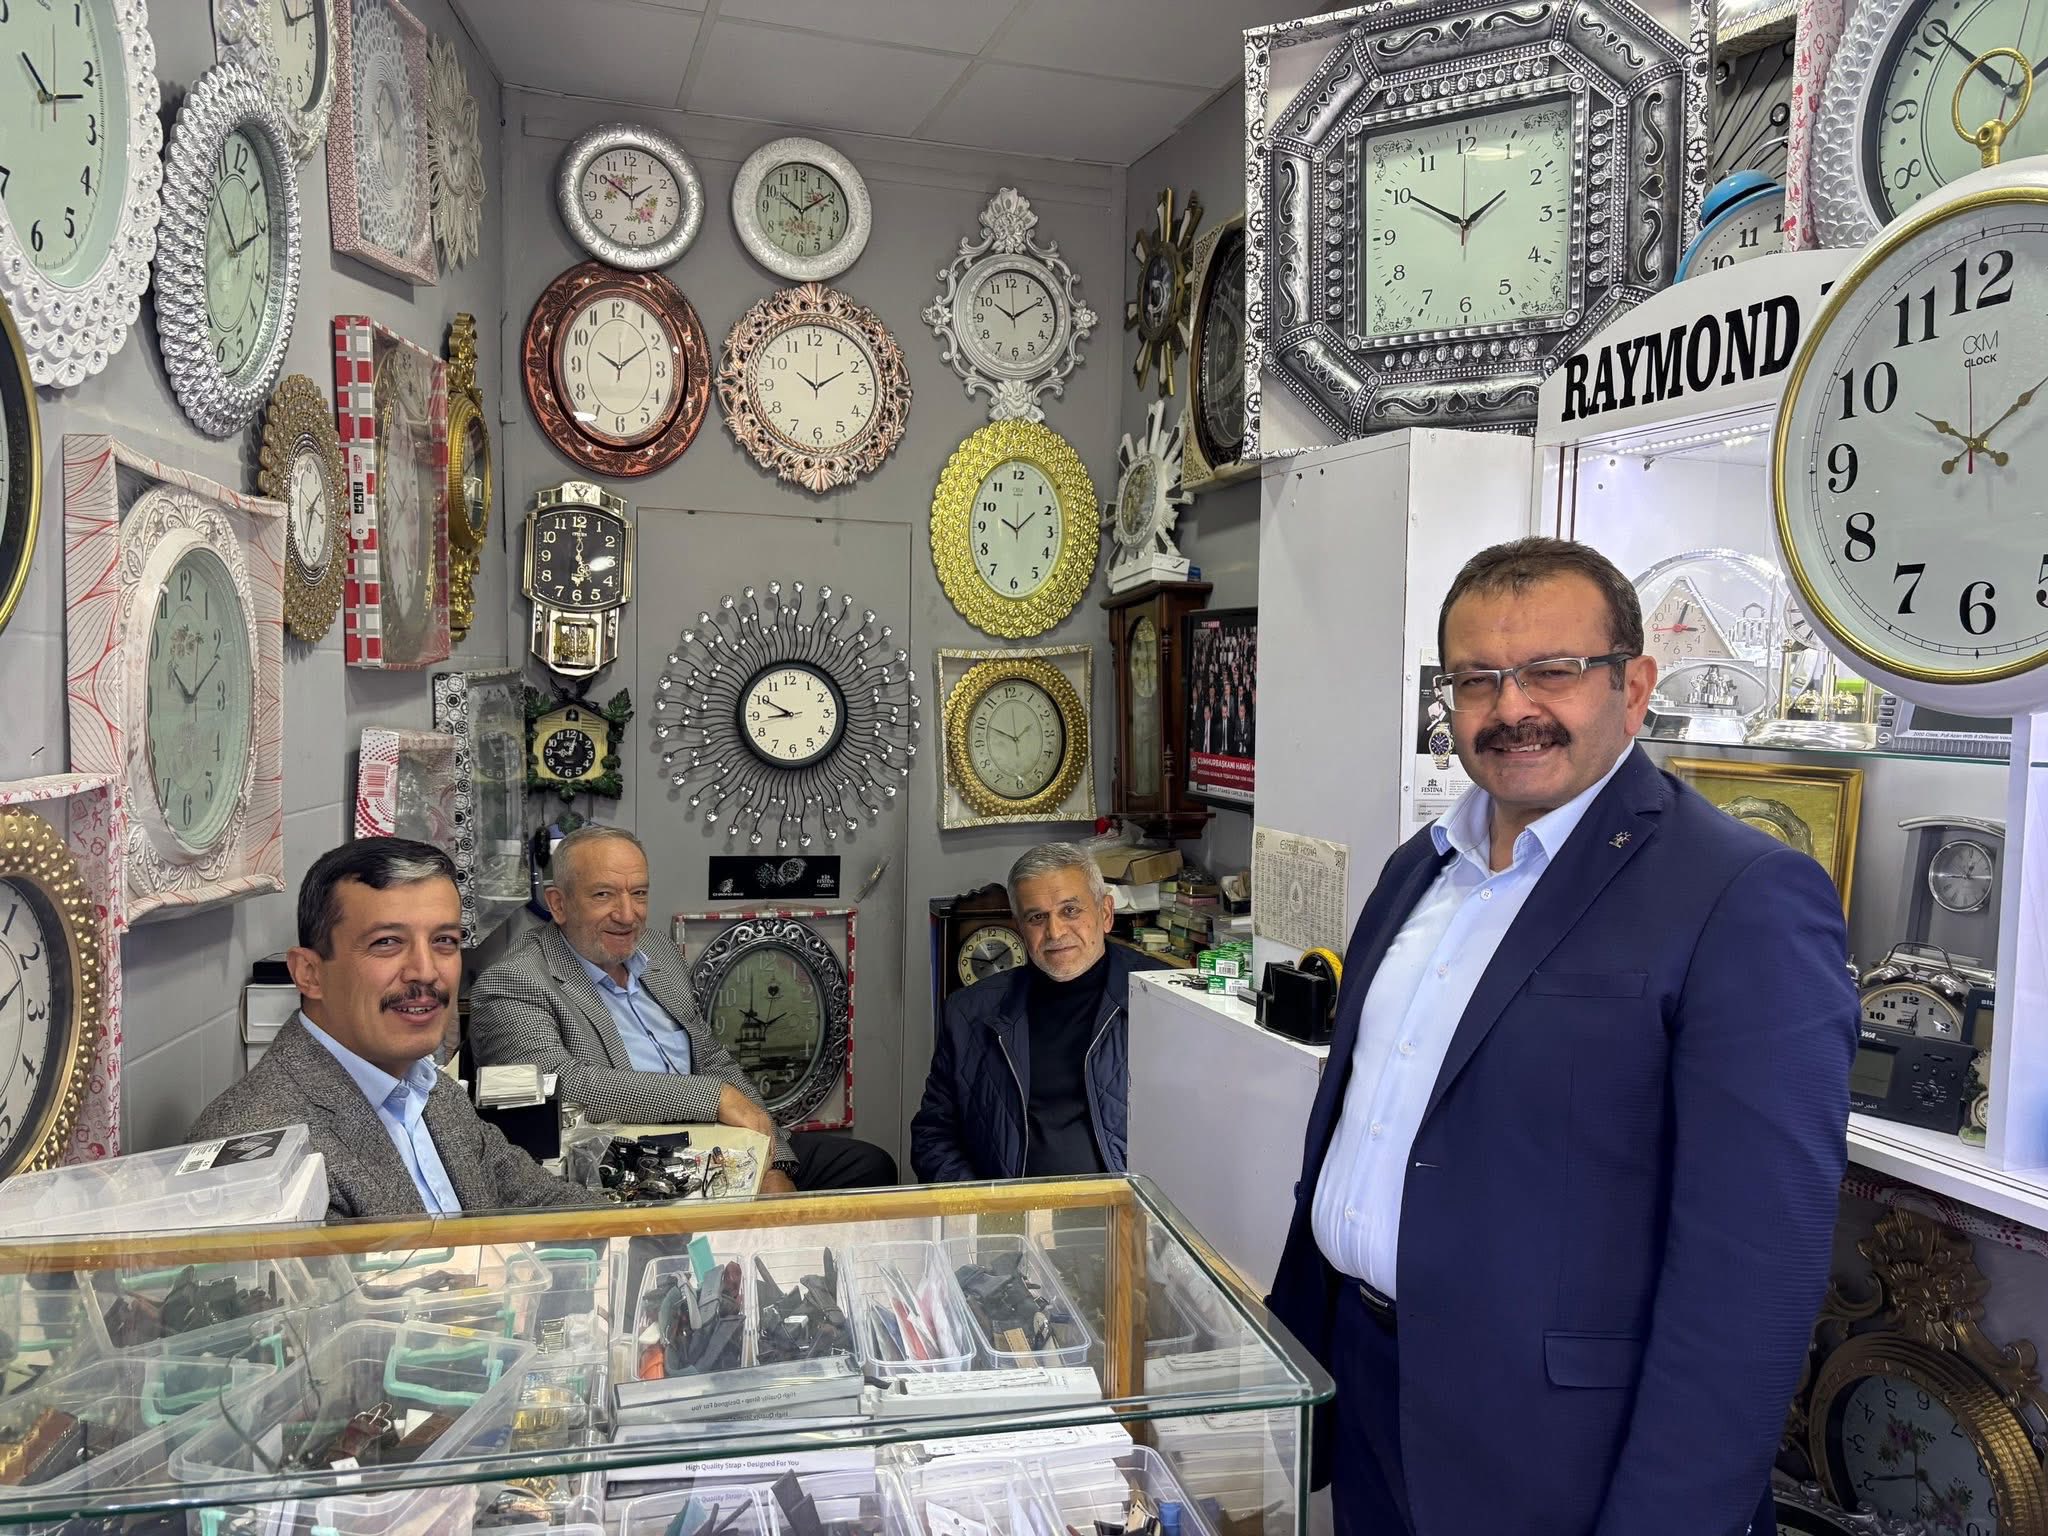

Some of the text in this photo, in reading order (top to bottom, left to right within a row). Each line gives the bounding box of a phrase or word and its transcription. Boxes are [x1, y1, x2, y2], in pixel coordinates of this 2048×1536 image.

[73, 0, 80, 27] 1
[1910, 17, 1949, 65] 10
[83, 61, 99, 87] 2
[86, 114, 97, 145] 3
[1456, 136, 1476, 156] 12
[1505, 144, 1512, 160] 1
[232, 143, 248, 174] 12
[607, 160, 616, 171] 11
[624, 156, 637, 167] 12
[1420, 155, 1436, 172] 11
[648, 165, 652, 174] 1
[1530, 168, 1542, 186] 2
[1894, 159, 1922, 189] 8
[80, 165, 96, 195] 4
[594, 174, 607, 185] 10
[660, 179, 667, 189] 2
[588, 191, 597, 201] 9
[665, 197, 673, 207] 3
[1393, 188, 1410, 205] 10
[595, 209, 602, 219] 8
[660, 214, 669, 224] 4
[1539, 205, 1553, 222] 3
[64, 207, 75, 239] 5
[610, 224, 617, 234] 7
[31, 220, 43, 252] 6
[628, 231, 637, 241] 6
[648, 226, 655, 236] 5
[1384, 229, 1396, 246] 9
[1739, 229, 1759, 248] 11
[1528, 247, 1541, 262] 4
[1711, 255, 1735, 272] 10
[254, 260, 265, 283] 3
[1393, 264, 1405, 280] 8
[1500, 278, 1512, 295] 5
[1949, 249, 2014, 316] 12
[1422, 289, 1433, 306] 7
[1460, 296, 1471, 314] 6
[612, 301, 625, 318] 12
[589, 310, 597, 326] 11
[640, 313, 644, 329] 1
[1894, 286, 1940, 349] 11
[574, 329, 588, 346] 10
[651, 334, 661, 350] 2
[807, 333, 822, 346] 12
[787, 341, 798, 353] 11
[836, 343, 841, 356] 1
[572, 356, 581, 373] 9
[771, 357, 787, 370] 10
[1560, 295, 1801, 423] RAYMOND
[1964, 354, 1997, 368] CLOCK
[656, 361, 666, 378] 3
[851, 361, 859, 373] 2
[576, 383, 586, 400] 8
[765, 379, 774, 391] 9
[858, 383, 867, 395] 3
[1839, 361, 1898, 420] 10
[650, 388, 659, 404] 4
[772, 401, 782, 413] 8
[851, 405, 861, 417] 4
[641, 407, 650, 424] 5
[615, 416, 625, 433] 6
[791, 419, 799, 431] 7
[836, 421, 845, 433] 5
[813, 427, 822, 439] 6
[1013, 471, 1025, 480] 12
[1827, 443, 1858, 493] 9
[993, 483, 1002, 492] 11
[1038, 486, 1042, 495] 1
[983, 502, 996, 512] 10
[1044, 506, 1052, 515] 2
[555, 518, 566, 529] 11
[573, 516, 587, 528] 12
[596, 521, 601, 532] 1
[978, 521, 986, 533] 9
[543, 531, 556, 543] 10
[1047, 526, 1053, 538] 3
[1844, 512, 1876, 562] 8
[606, 536, 615, 547] 2
[542, 550, 551, 561] 9
[980, 543, 989, 556] 8
[1042, 547, 1049, 559] 4
[542, 570, 551, 581] 8
[990, 564, 998, 576] 7
[1031, 567, 1039, 579] 5
[179, 568, 192, 602] 12
[603, 576, 613, 587] 4
[1010, 577, 1018, 589] 6
[1893, 563, 1926, 614] 7
[555, 586, 564, 597] 7
[572, 590, 582, 601] 6
[591, 589, 600, 600] 5
[204, 592, 209, 621] 1
[1959, 581, 1997, 635] 6
[213, 628, 221, 661] 2
[216, 680, 226, 711] 3
[212, 731, 220, 762] 4
[205, 771, 212, 801] 5
[183, 792, 192, 825] 6
[1, 904, 19, 936] 1
[19, 941, 41, 970] 2
[1883, 1001, 1895, 1009] 11
[1902, 997, 1919, 1005] 12
[27, 998, 45, 1022] 3
[1869, 1012, 1885, 1020] 10
[22, 1052, 36, 1087] 4
[701, 1463, 723, 1471] Quality
[725, 1462, 741, 1470] Strap
[747, 1460, 775, 1468] Designed
